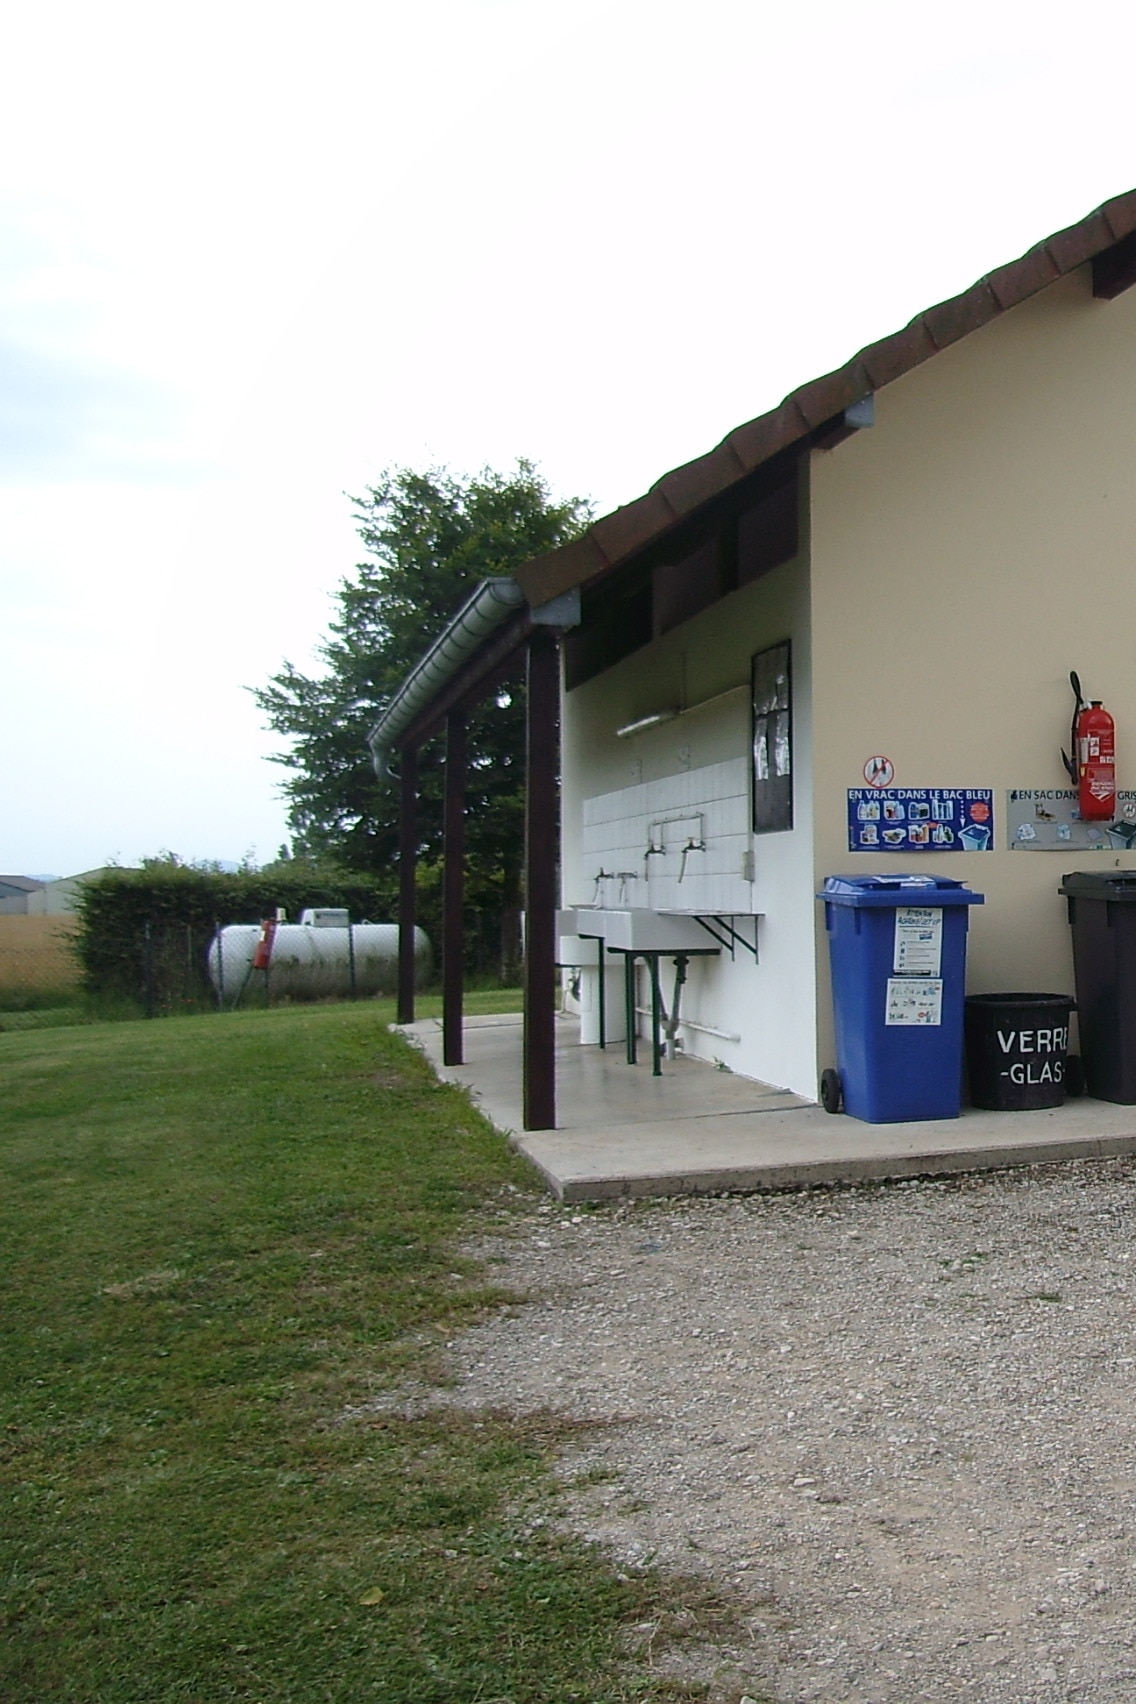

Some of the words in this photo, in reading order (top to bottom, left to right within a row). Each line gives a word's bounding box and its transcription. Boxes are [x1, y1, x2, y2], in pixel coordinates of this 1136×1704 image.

[849, 790, 862, 800] EN
[865, 790, 895, 800] VRAC
[898, 790, 926, 800] DANS
[930, 790, 941, 800] LE
[943, 790, 964, 800] BAC
[966, 790, 990, 800] BLEU
[1019, 790, 1032, 800] EN
[1034, 790, 1053, 800] SAC
